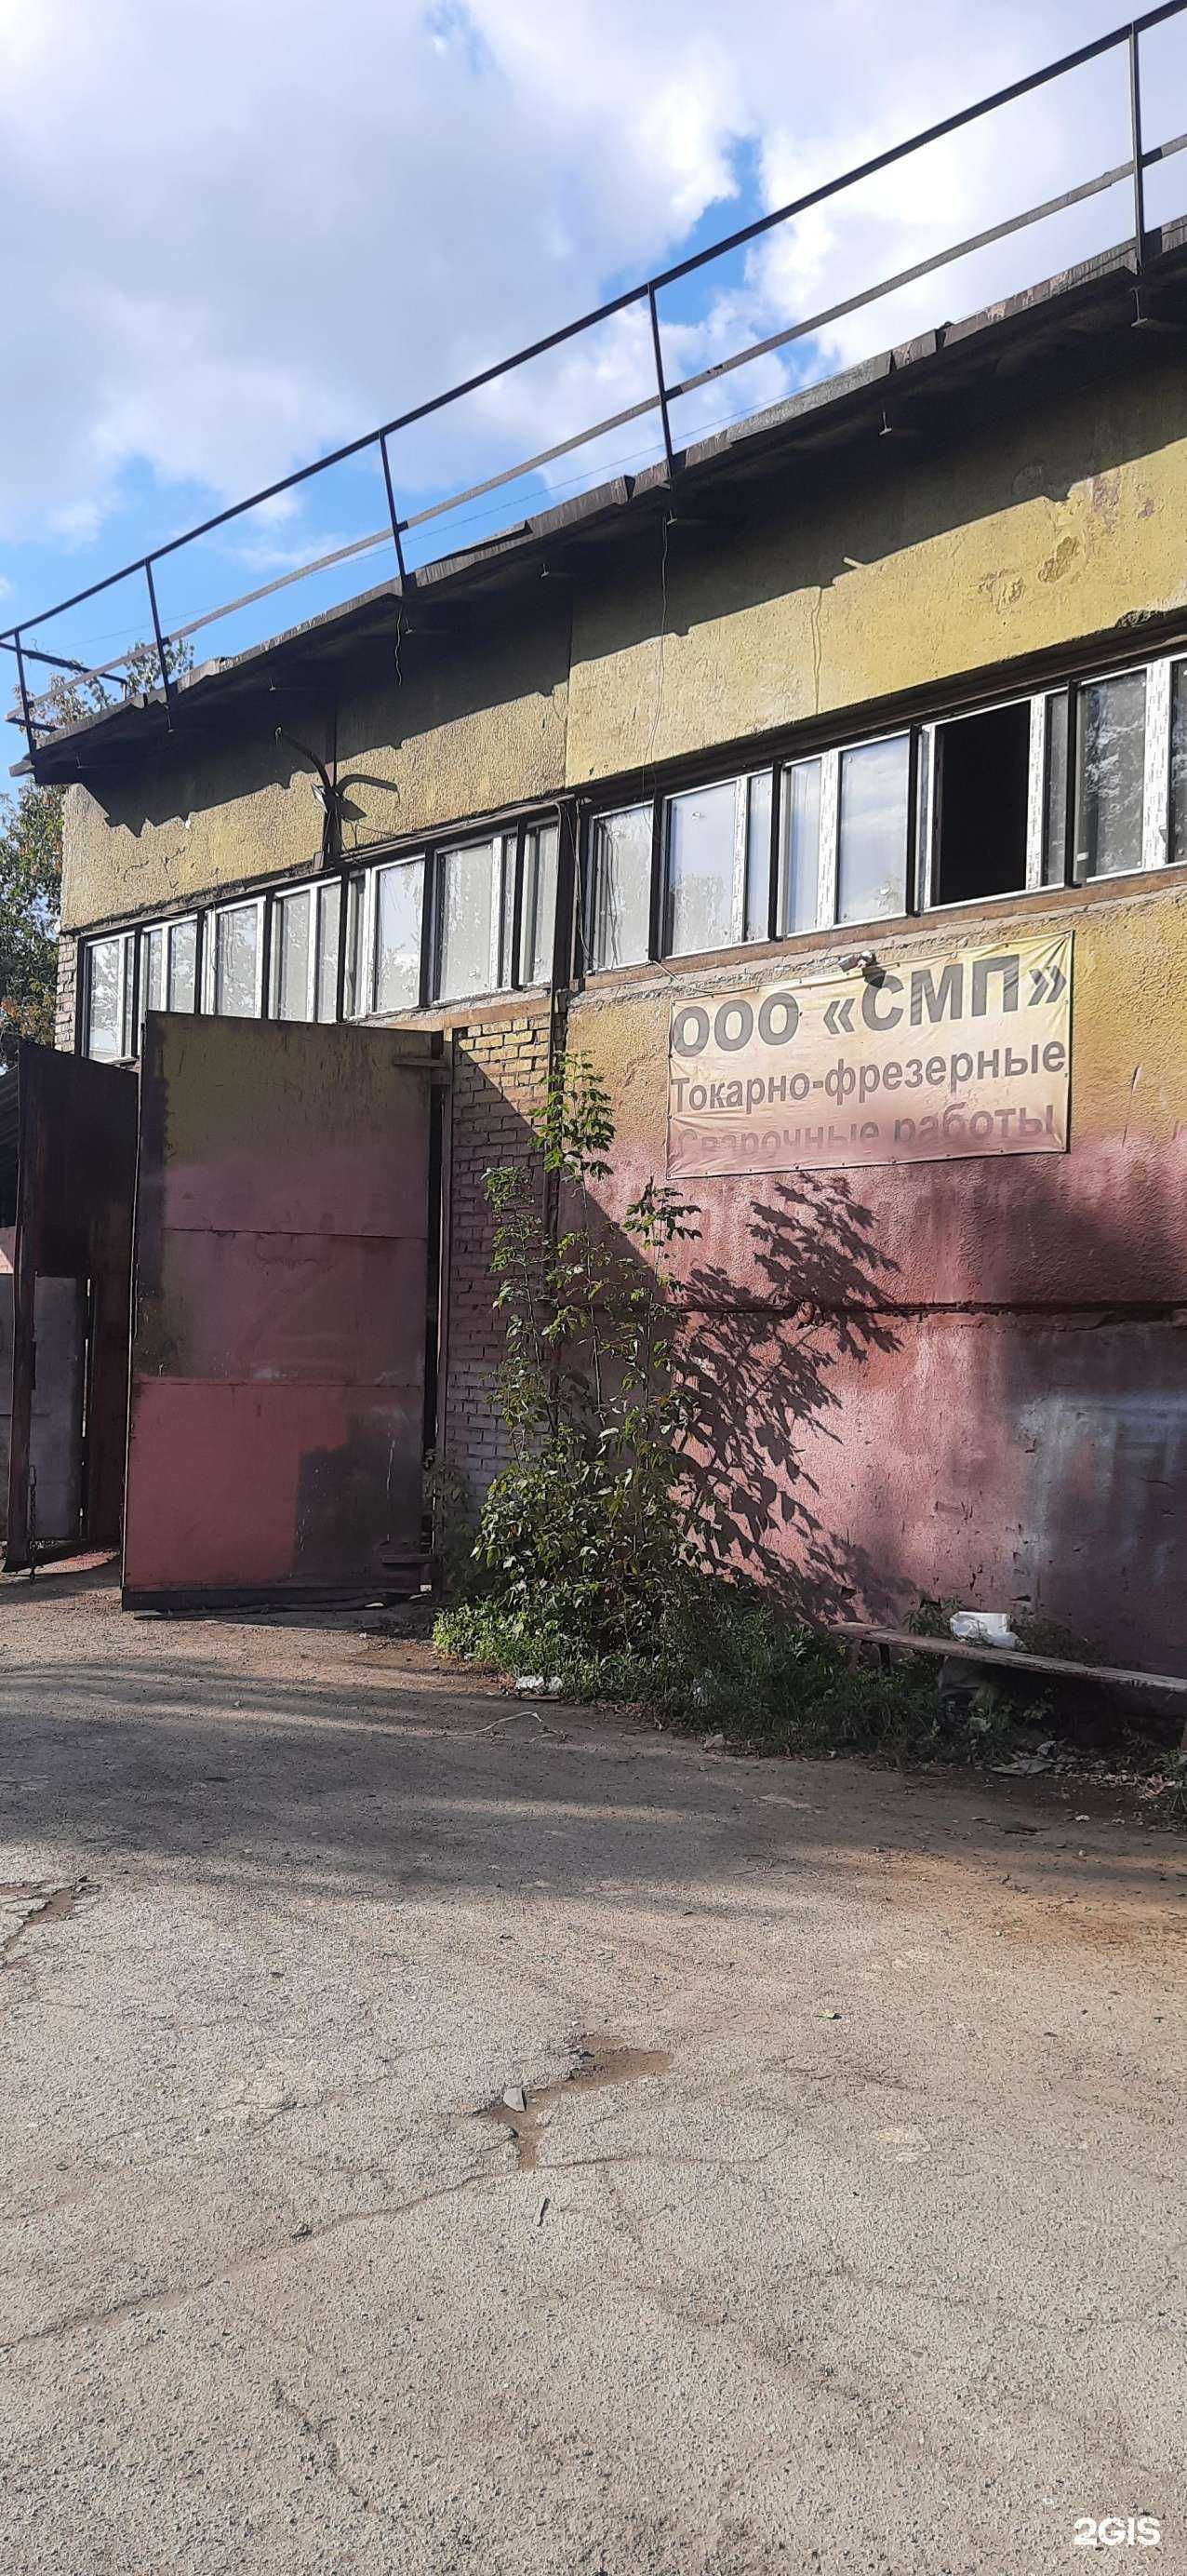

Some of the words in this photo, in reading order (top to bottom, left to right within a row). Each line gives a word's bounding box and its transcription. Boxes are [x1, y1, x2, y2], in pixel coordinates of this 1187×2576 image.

[673, 992, 799, 1058] ООО
[823, 954, 1067, 1035] «СМП»
[671, 1040, 1066, 1114] Токарно-фрезерные
[894, 1101, 1054, 1145] работы
